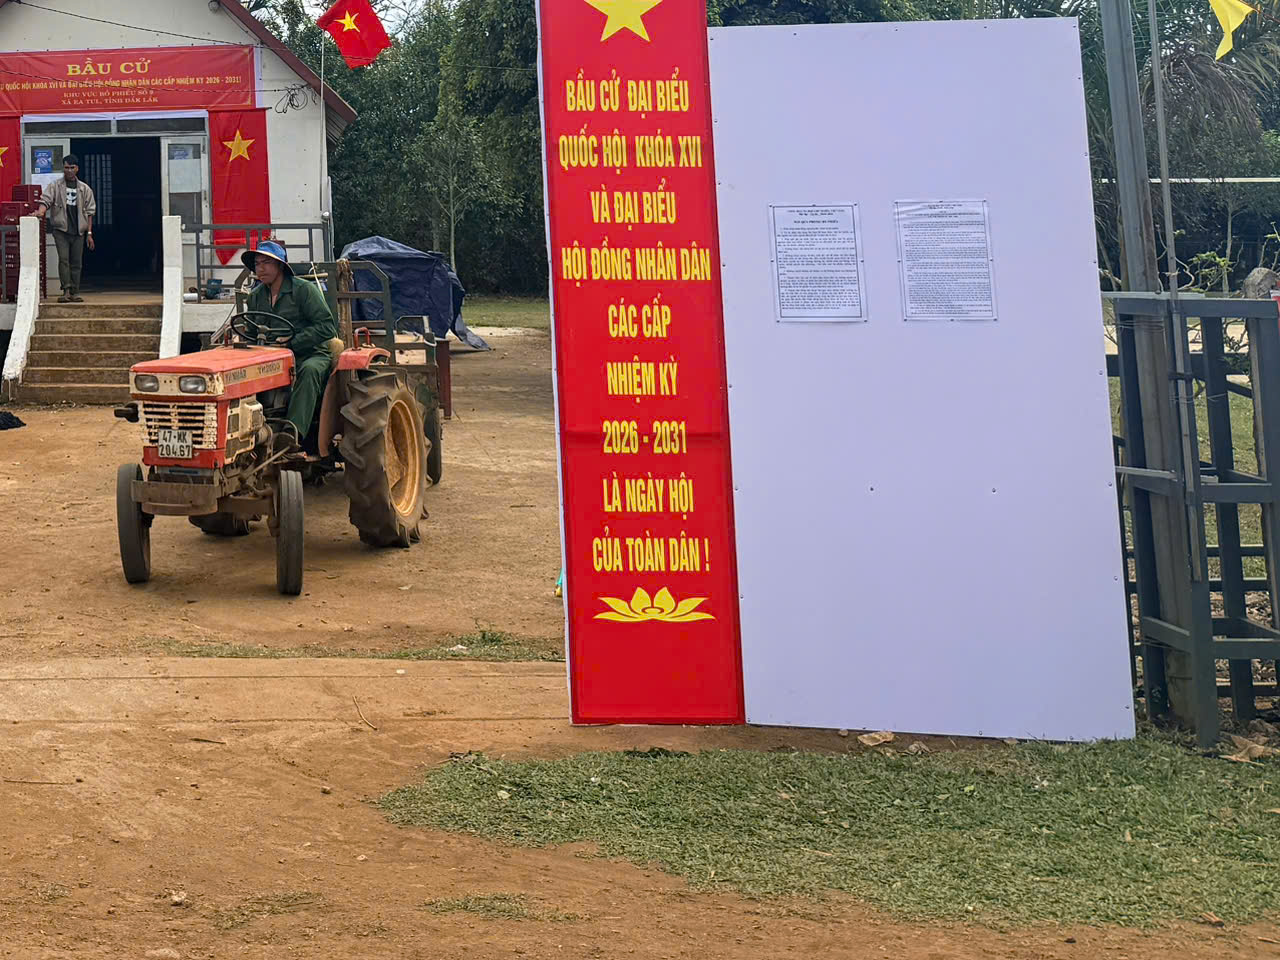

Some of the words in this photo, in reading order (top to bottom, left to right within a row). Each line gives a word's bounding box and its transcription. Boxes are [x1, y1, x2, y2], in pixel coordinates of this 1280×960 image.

[66, 57, 112, 76] BẦU
[119, 58, 151, 74] CỬ
[566, 70, 595, 111] BẦU
[600, 69, 620, 111] CỬ
[628, 80, 652, 118] ĐẠI
[656, 68, 689, 112] BIỂU
[559, 124, 599, 170] QUỐC
[602, 129, 627, 174] HỘI
[635, 130, 675, 168] KHÓA
[678, 136, 702, 167] XVI
[590, 185, 611, 224] VÀ
[614, 192, 639, 230] ĐẠI
[643, 178, 676, 224] BIỂU
[562, 240, 587, 286] HỘI
[591, 237, 632, 280] ĐỒNG
[636, 241, 677, 280] NHÂN
[681, 242, 711, 280] DÂN
[608, 299, 637, 337] CÁC
[642, 294, 671, 337] CẤP
[608, 356, 655, 402] NHIỆM
[659, 356, 677, 395] KỲ
[603, 421, 638, 453] 2026
[653, 421, 686, 454] 2031
[603, 472, 622, 512] LÀ
[626, 472, 664, 512] NGÀY
[669, 472, 693, 520] HỘI
[593, 527, 623, 571] CỦA
[625, 531, 665, 572] TOÀN
[669, 531, 700, 571] DÂN
